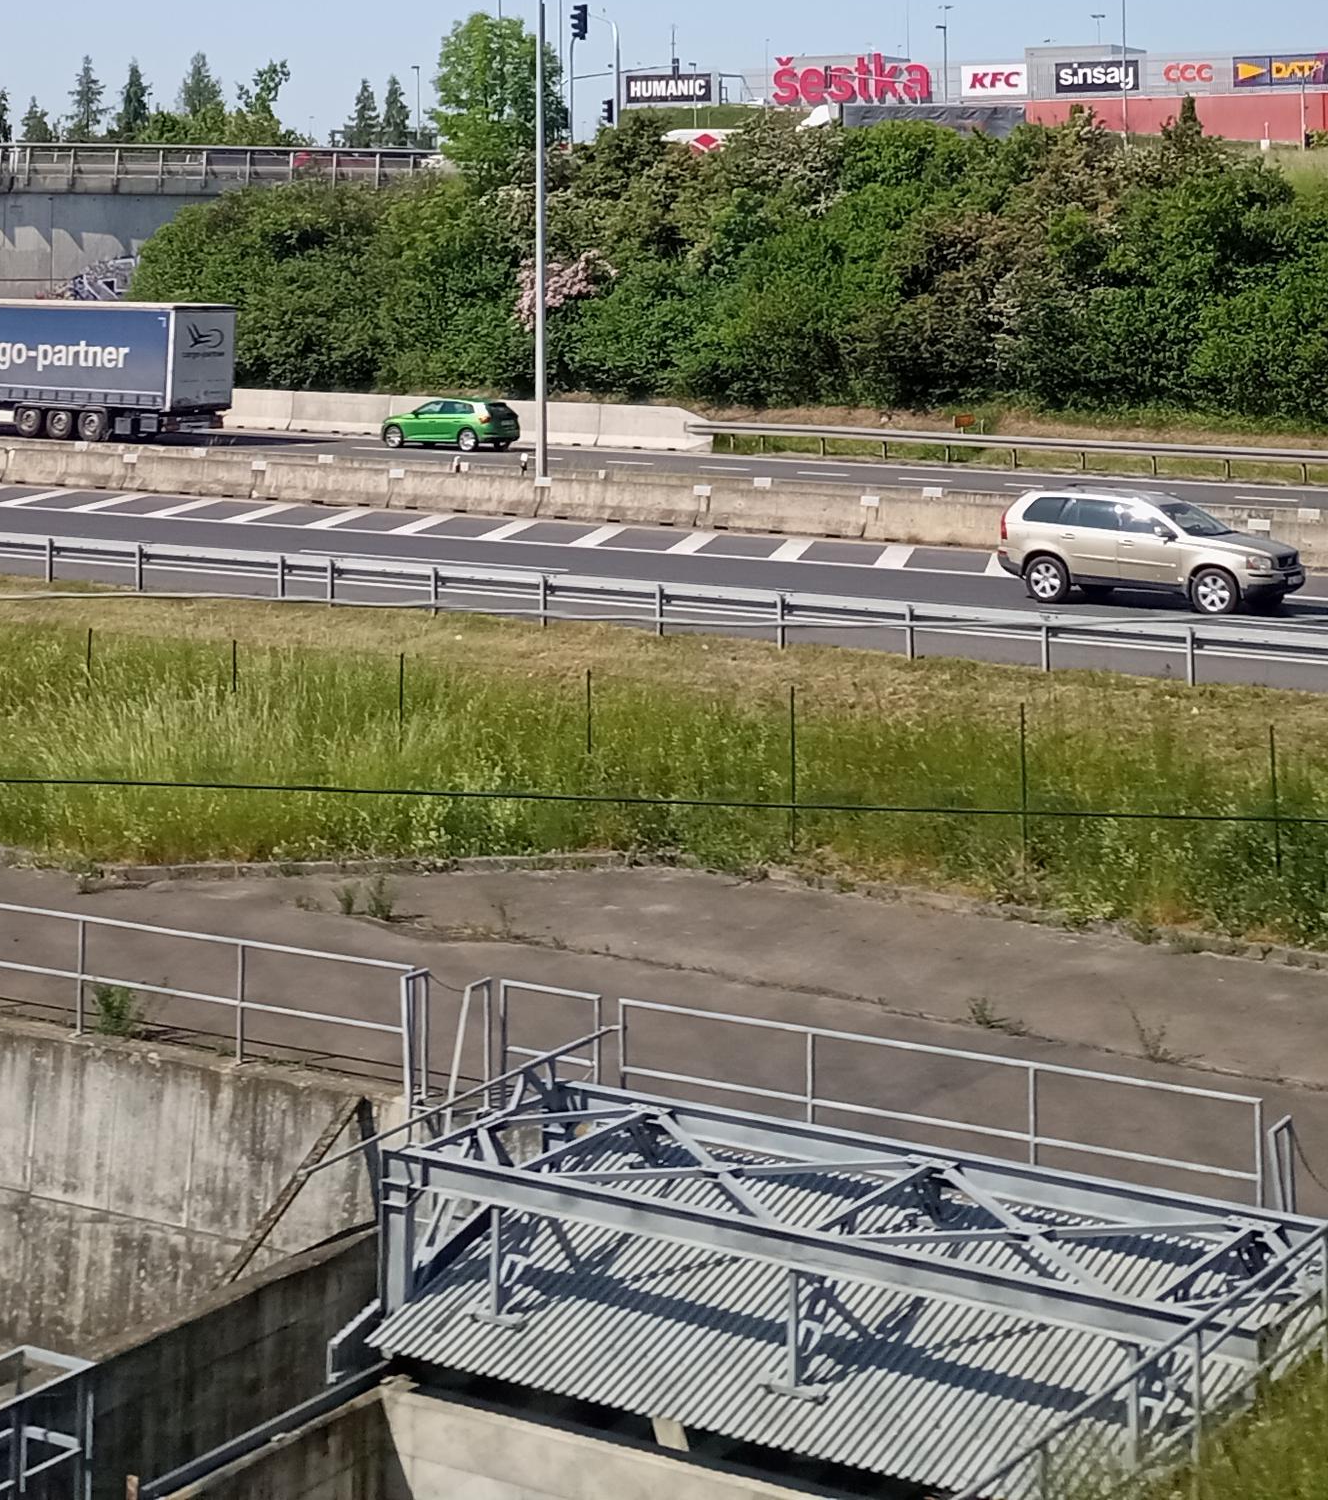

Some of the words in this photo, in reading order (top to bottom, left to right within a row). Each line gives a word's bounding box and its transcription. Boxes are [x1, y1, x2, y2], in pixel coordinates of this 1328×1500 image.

[629, 78, 706, 98] HUMANIC
[773, 52, 932, 104] šestka
[969, 71, 1022, 89] KFC
[1059, 62, 1134, 90] sinsay
